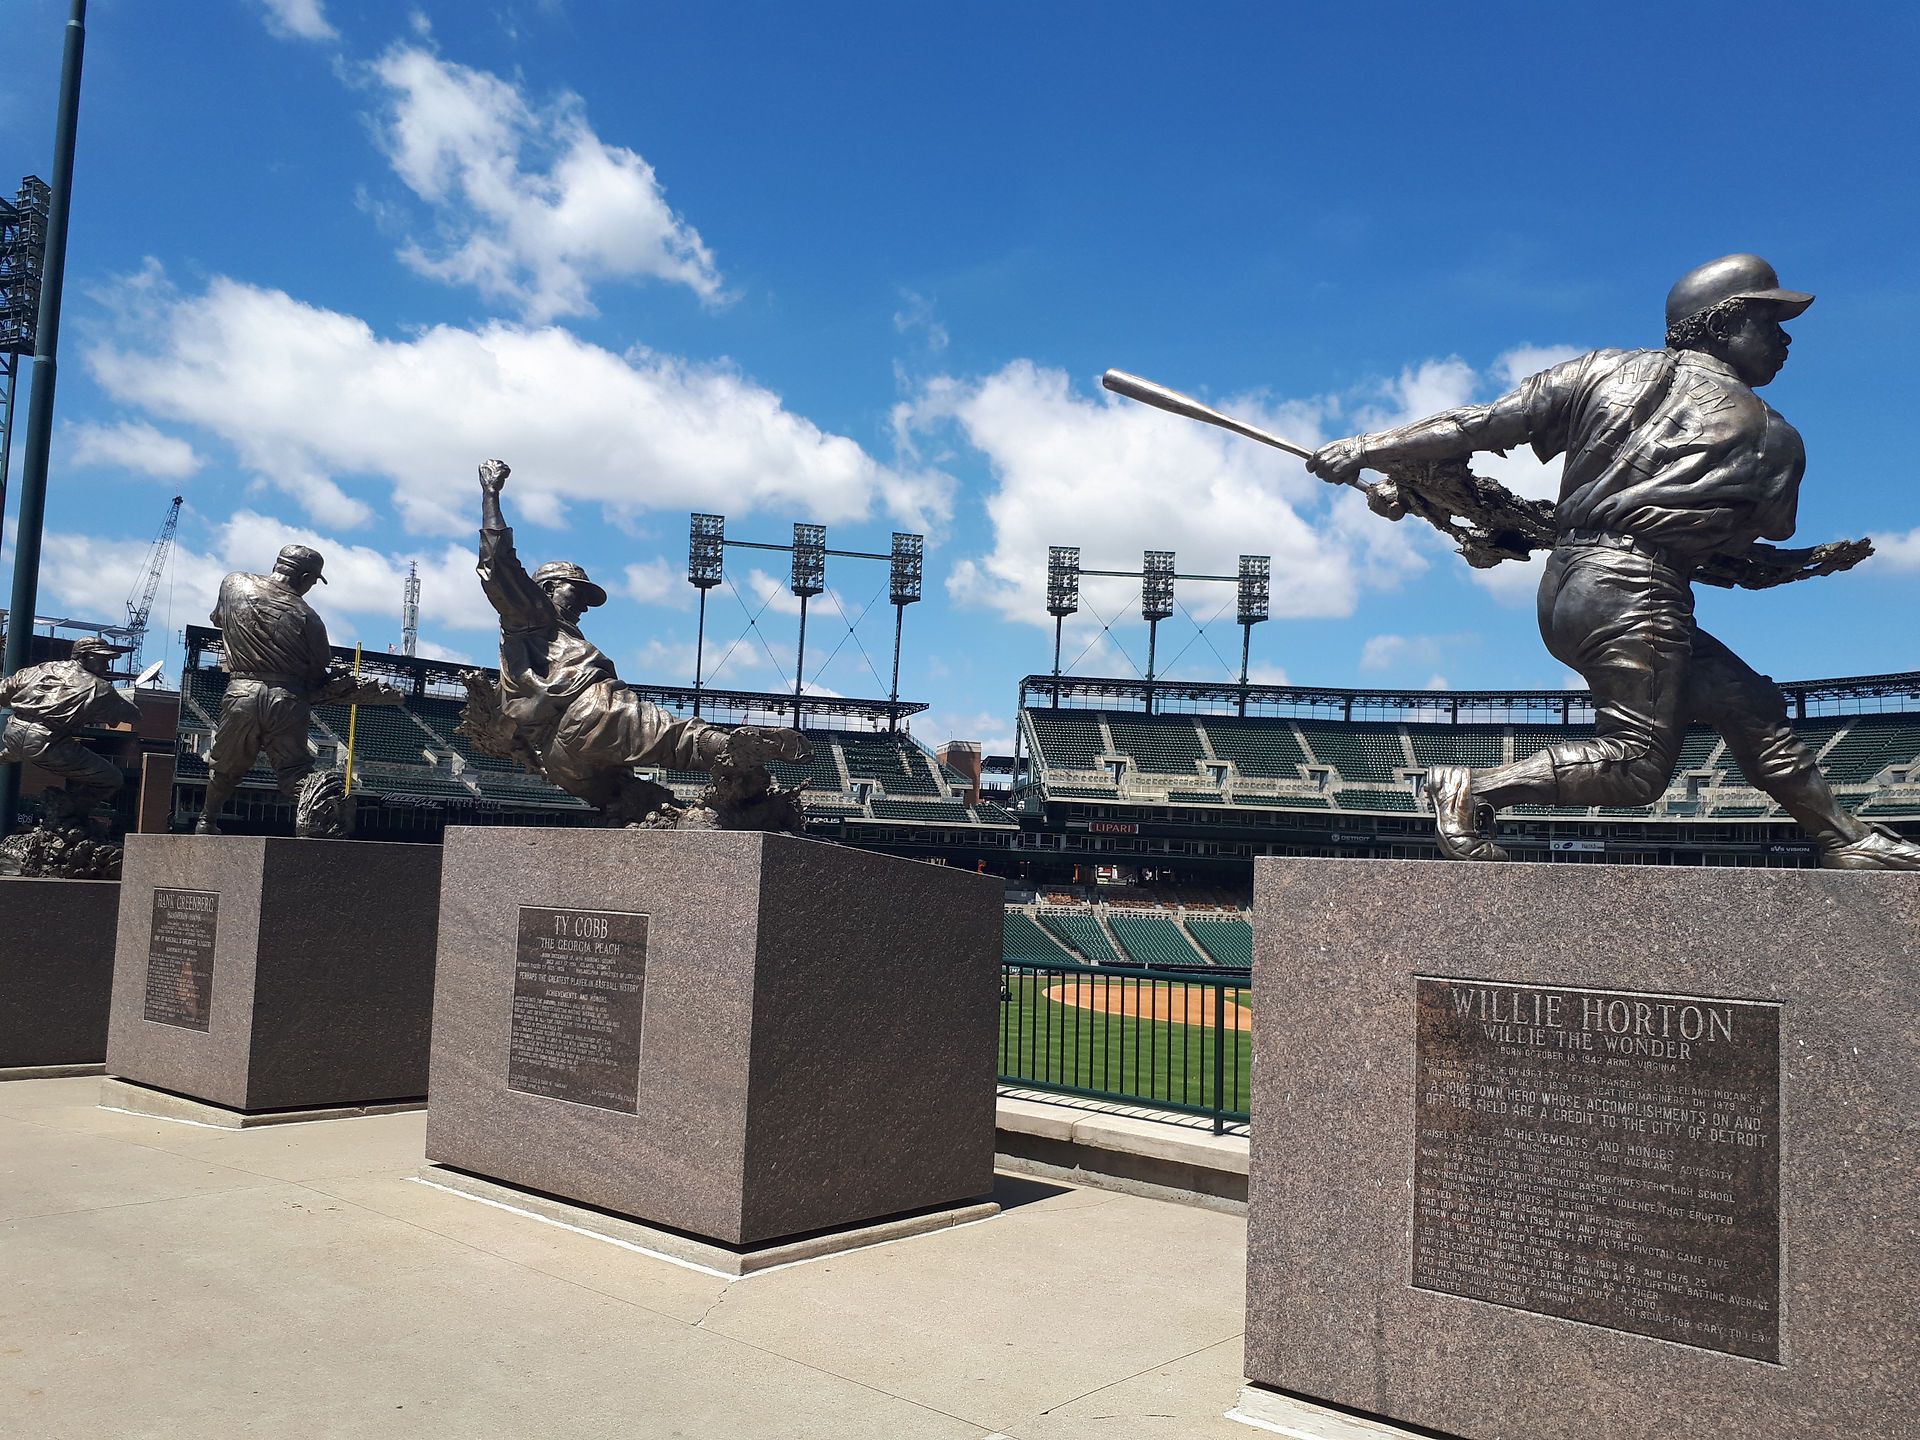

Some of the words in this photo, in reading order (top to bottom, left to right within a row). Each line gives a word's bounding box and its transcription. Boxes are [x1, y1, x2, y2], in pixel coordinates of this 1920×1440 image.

[1095, 823, 1132, 833] LIPARI
[157, 893, 174, 908] HANK
[176, 895, 214, 912] GREENBERG
[554, 915, 569, 935] TY
[575, 916, 608, 939] COBB
[558, 939, 591, 953] GEORGIA
[1451, 988, 1563, 1028] WILLIE
[1582, 997, 1732, 1043] HORTON
[1557, 1030, 1592, 1051] THE
[1501, 1046, 1521, 1056] BORN
[1525, 1049, 1563, 1061] OCTOBER
[1582, 1055, 1602, 1064] 1942
[1638, 1060, 1676, 1072] VIRGINIA
[1443, 1081, 1502, 1100] HOMETOWN
[1507, 1088, 1535, 1104] HERO
[1541, 1092, 1580, 1109] WHOSE
[1586, 1098, 1706, 1125] ACCOMPLISHMENTS
[1713, 1113, 1728, 1127] ON
[1734, 1115, 1761, 1131] AND
[1592, 1086, 1633, 1098] SEATTLE
[1713, 1099, 1734, 1110] 1979
[1426, 1092, 1443, 1106] OFF
[1451, 1095, 1471, 1110] THE
[1476, 1099, 1506, 1114] FIELD
[1512, 1103, 1533, 1118] ARE
[1540, 1106, 1547, 1119] A
[1554, 1108, 1593, 1125] CREDIT
[1601, 1114, 1615, 1128] TO
[1623, 1116, 1645, 1132] THE
[1652, 1120, 1684, 1137] CITY
[1688, 1125, 1701, 1139] OF
[1710, 1127, 1767, 1148] DETROIT
[1502, 1127, 1587, 1149] ACHIEVEMENTS
[1597, 1140, 1618, 1153] AND
[1627, 1144, 1674, 1161] HONORS
[1515, 1141, 1550, 1155] HOUSING
[1555, 1147, 1594, 1161] PROJECT
[1601, 1153, 1617, 1164] AND
[1421, 1148, 1438, 1158] WAS
[1498, 1159, 1519, 1170] STAR
[1524, 1163, 1538, 1173] FOR
[1672, 1185, 1692, 1196] HIGH
[1698, 1189, 1735, 1203] SCHOOL
[1499, 1170, 1532, 1182] DETROIT
[1537, 1176, 1574, 1189] SANDLOT
[1579, 1182, 1623, 1197] BASEBALL
[1421, 1167, 1437, 1177] WAS
[1441, 1170, 1499, 1187] INSTRUMENTAL
[1518, 1182, 1551, 1196] HELPING
[1591, 1194, 1607, 1205] THE
[1613, 1197, 1655, 1213] VIOLENCE
[1661, 1205, 1684, 1217] THAT
[1690, 1209, 1732, 1225] ERUPTED
[1421, 1187, 1451, 1200] BATTED
[1494, 1199, 1515, 1211] FIRST
[1521, 1204, 1553, 1217] SEASON
[1558, 1210, 1579, 1221] WITH
[1585, 1214, 1601, 1225] THE
[1517, 1193, 1541, 1204] RIOTS
[1559, 1199, 1594, 1213] DETROIT
[1421, 1197, 1434, 1206] HAD
[1474, 1206, 1495, 1217] MORE
[1530, 1215, 1549, 1226] 1965
[1578, 1223, 1596, 1234] AND
[1420, 1206, 1446, 1219] THREW
[1452, 1212, 1465, 1222] OUT
[1471, 1215, 1485, 1226] LOU
[1490, 1218, 1517, 1231] BROCK
[1539, 1227, 1562, 1239] HOME
[1566, 1232, 1593, 1245] PLATE
[1612, 1240, 1629, 1251] THE
[1634, 1243, 1671, 1259] PIVOTAL
[1678, 1251, 1703, 1265] GAME
[1708, 1256, 1729, 1269] FIVE
[1498, 1230, 1525, 1243] WORLD
[1529, 1236, 1558, 1249] SERIES
[1439, 1230, 1453, 1240] THE
[1497, 1241, 1519, 1252] HOME
[1524, 1246, 1545, 1257] RUNS
[1549, 1250, 1569, 1262] 1968
[1644, 1268, 1662, 1279] AND
[1419, 1255, 1433, 1265] HAD
[1439, 1259, 1449, 1269] HIS
[1454, 1262, 1488, 1276] UNIFORM
[1494, 1270, 1527, 1284] NUMBER
[1546, 1280, 1582, 1295] RETIRED
[1588, 1288, 1610, 1301] JULY
[1631, 1297, 1655, 1310] 2000
[1420, 1246, 1435, 1256] WAS
[1439, 1249, 1473, 1264] ELECTED
[1494, 1260, 1514, 1272] FOUR
[1522, 1265, 1536, 1276] ALL
[1541, 1269, 1561, 1281] STAR
[1568, 1274, 1596, 1288] TEAMS
[1632, 1287, 1658, 1300] TIGER
[1483, 1248, 1504, 1260] HOME
[1573, 1265, 1589, 1276] AND
[1593, 1268, 1608, 1280] HAD
[1645, 1278, 1683, 1294] LIFETIME
[1687, 1286, 1724, 1302] BATTING
[1729, 1294, 1770, 1311] AVERAGE
[1418, 1275, 1460, 1291] DEDICATED
[1467, 1285, 1485, 1297] JULY
[1504, 1293, 1525, 1305] 2000
[1468, 1275, 1490, 1287] JULIE
[1539, 1290, 1574, 1305] AMRANY
